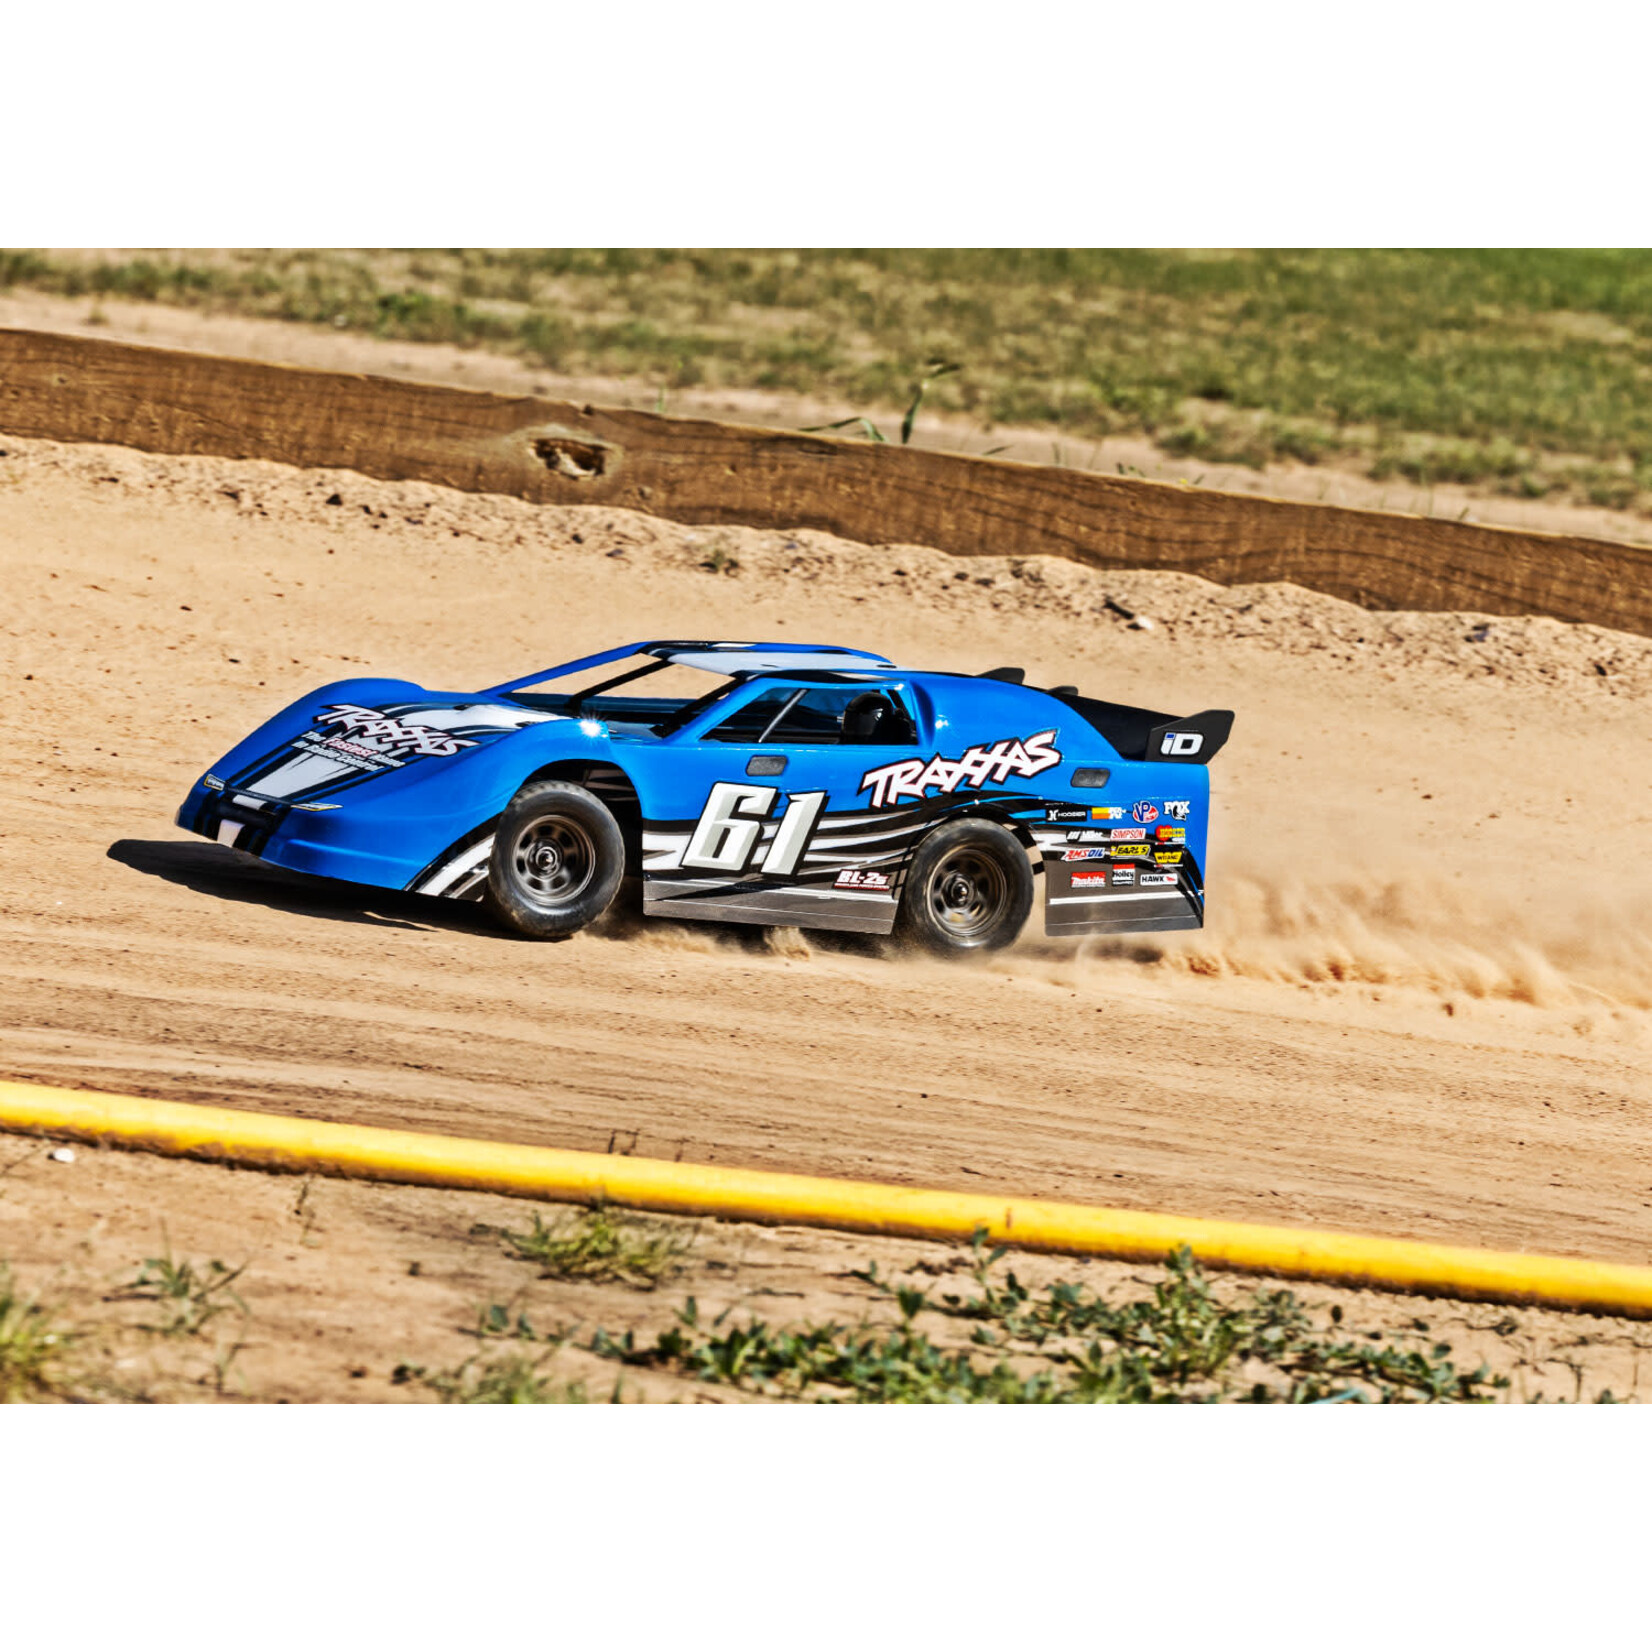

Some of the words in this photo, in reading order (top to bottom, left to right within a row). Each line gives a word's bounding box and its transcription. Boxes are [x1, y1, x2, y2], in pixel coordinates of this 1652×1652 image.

[316, 704, 480, 757] TRAXXAS
[861, 729, 1061, 808] TRAXXAS
[681, 782, 825, 875] 61
[1112, 829, 1144, 839] SIMPSON
[1064, 849, 1104, 860] AMSOIL
[1141, 875, 1164, 883] HAWK
